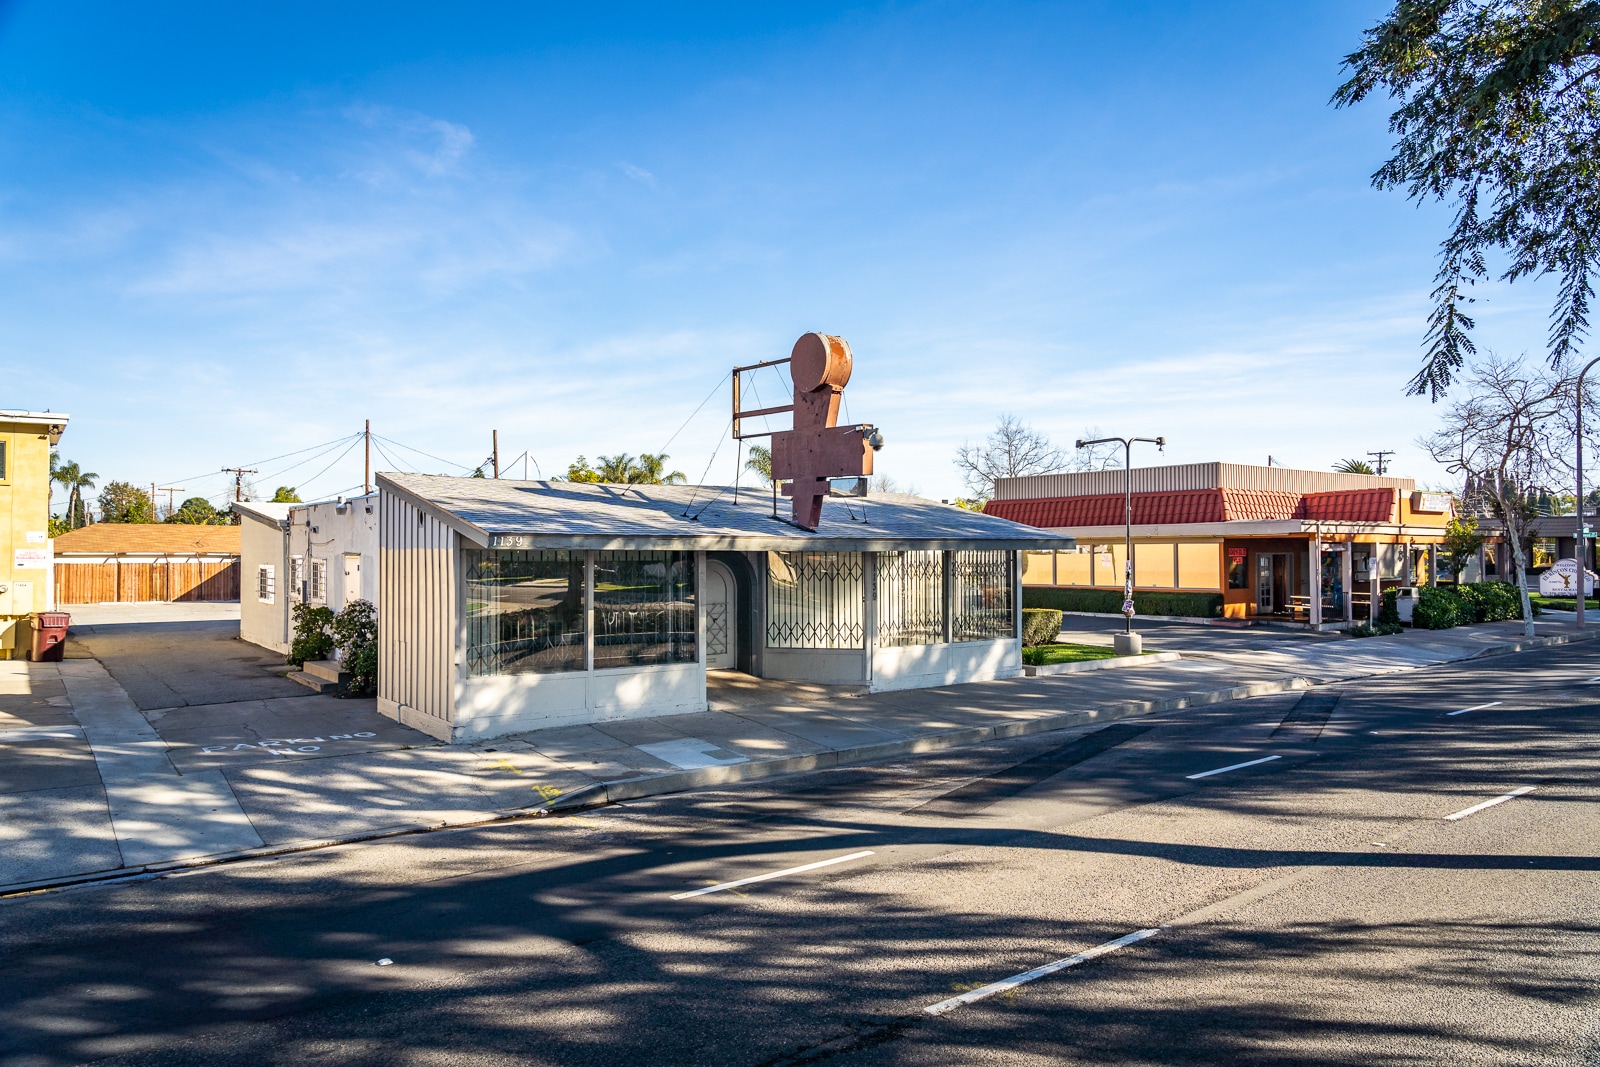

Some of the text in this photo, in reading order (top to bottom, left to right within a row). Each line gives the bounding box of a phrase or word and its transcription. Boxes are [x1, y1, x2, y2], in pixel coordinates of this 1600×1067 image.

[493, 536, 523, 547] 1139
[1547, 567, 1568, 577] RINCON
[202, 732, 377, 753] PARKING
[267, 745, 321, 756] NO
